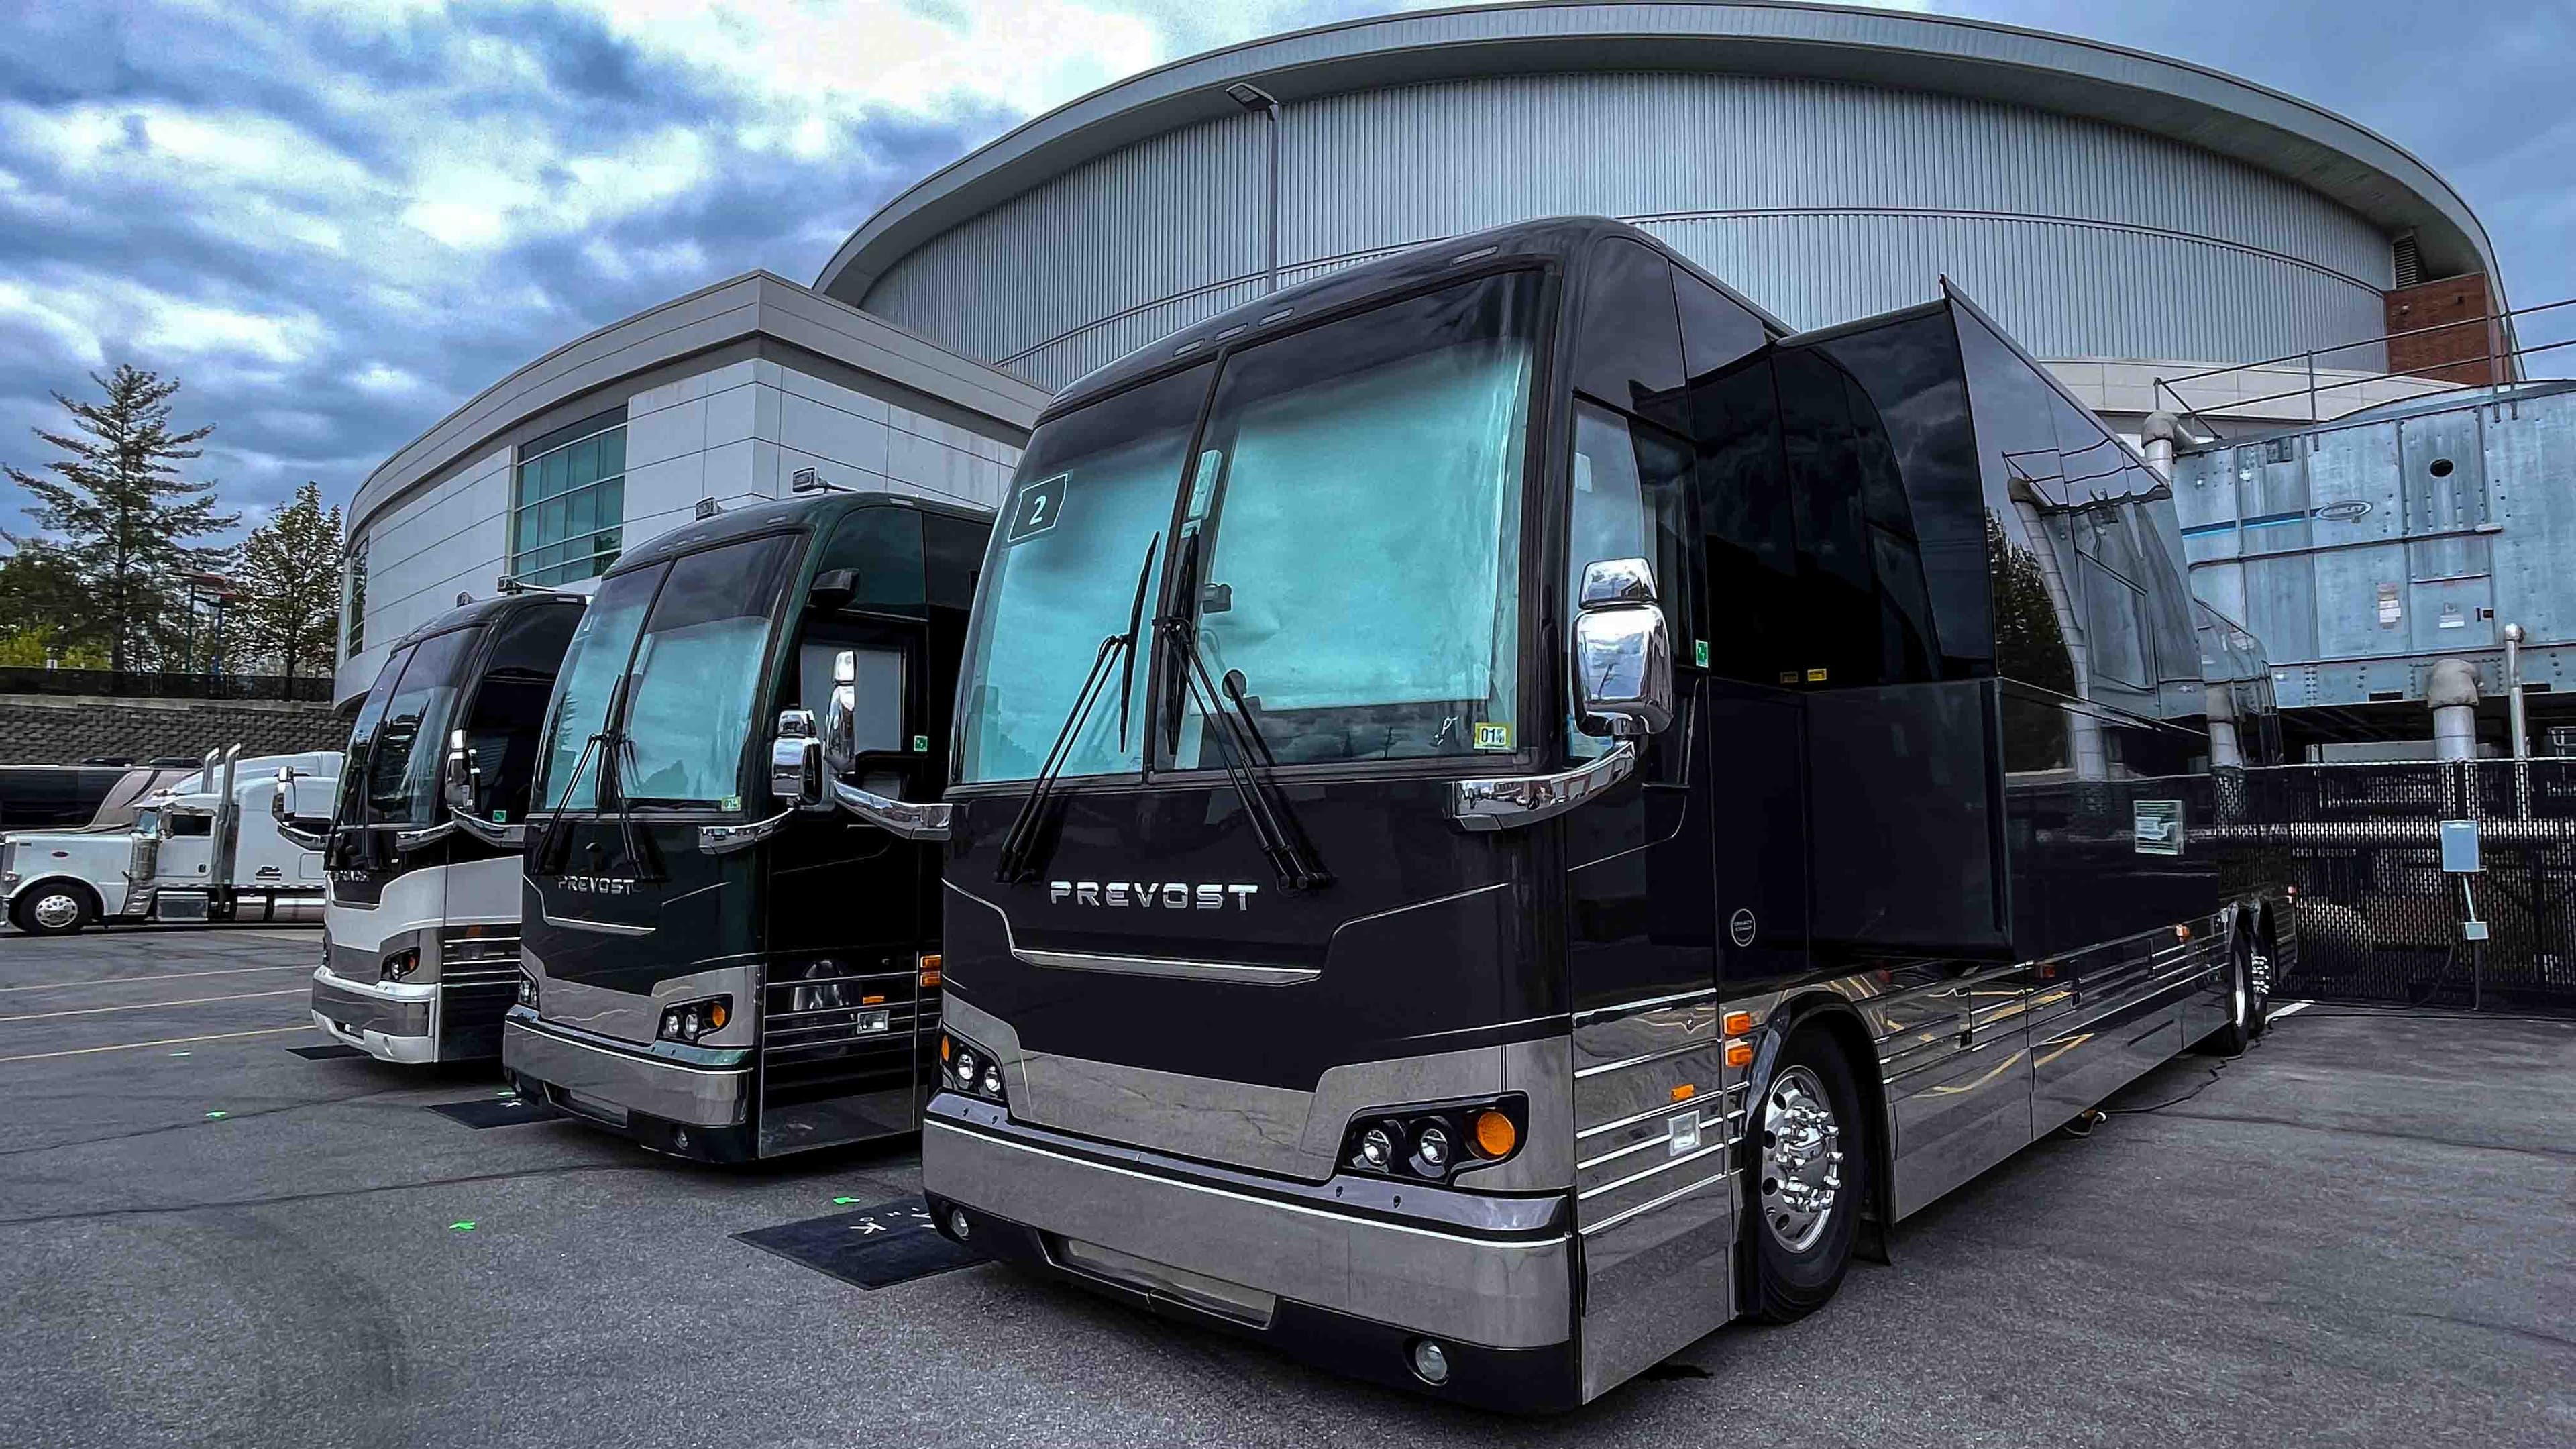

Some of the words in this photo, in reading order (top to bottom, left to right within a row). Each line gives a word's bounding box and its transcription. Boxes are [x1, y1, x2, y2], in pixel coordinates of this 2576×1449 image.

[1029, 495, 1047, 525] 2
[558, 875, 635, 895] PREVOST
[1050, 881, 1258, 911] PREVOST
